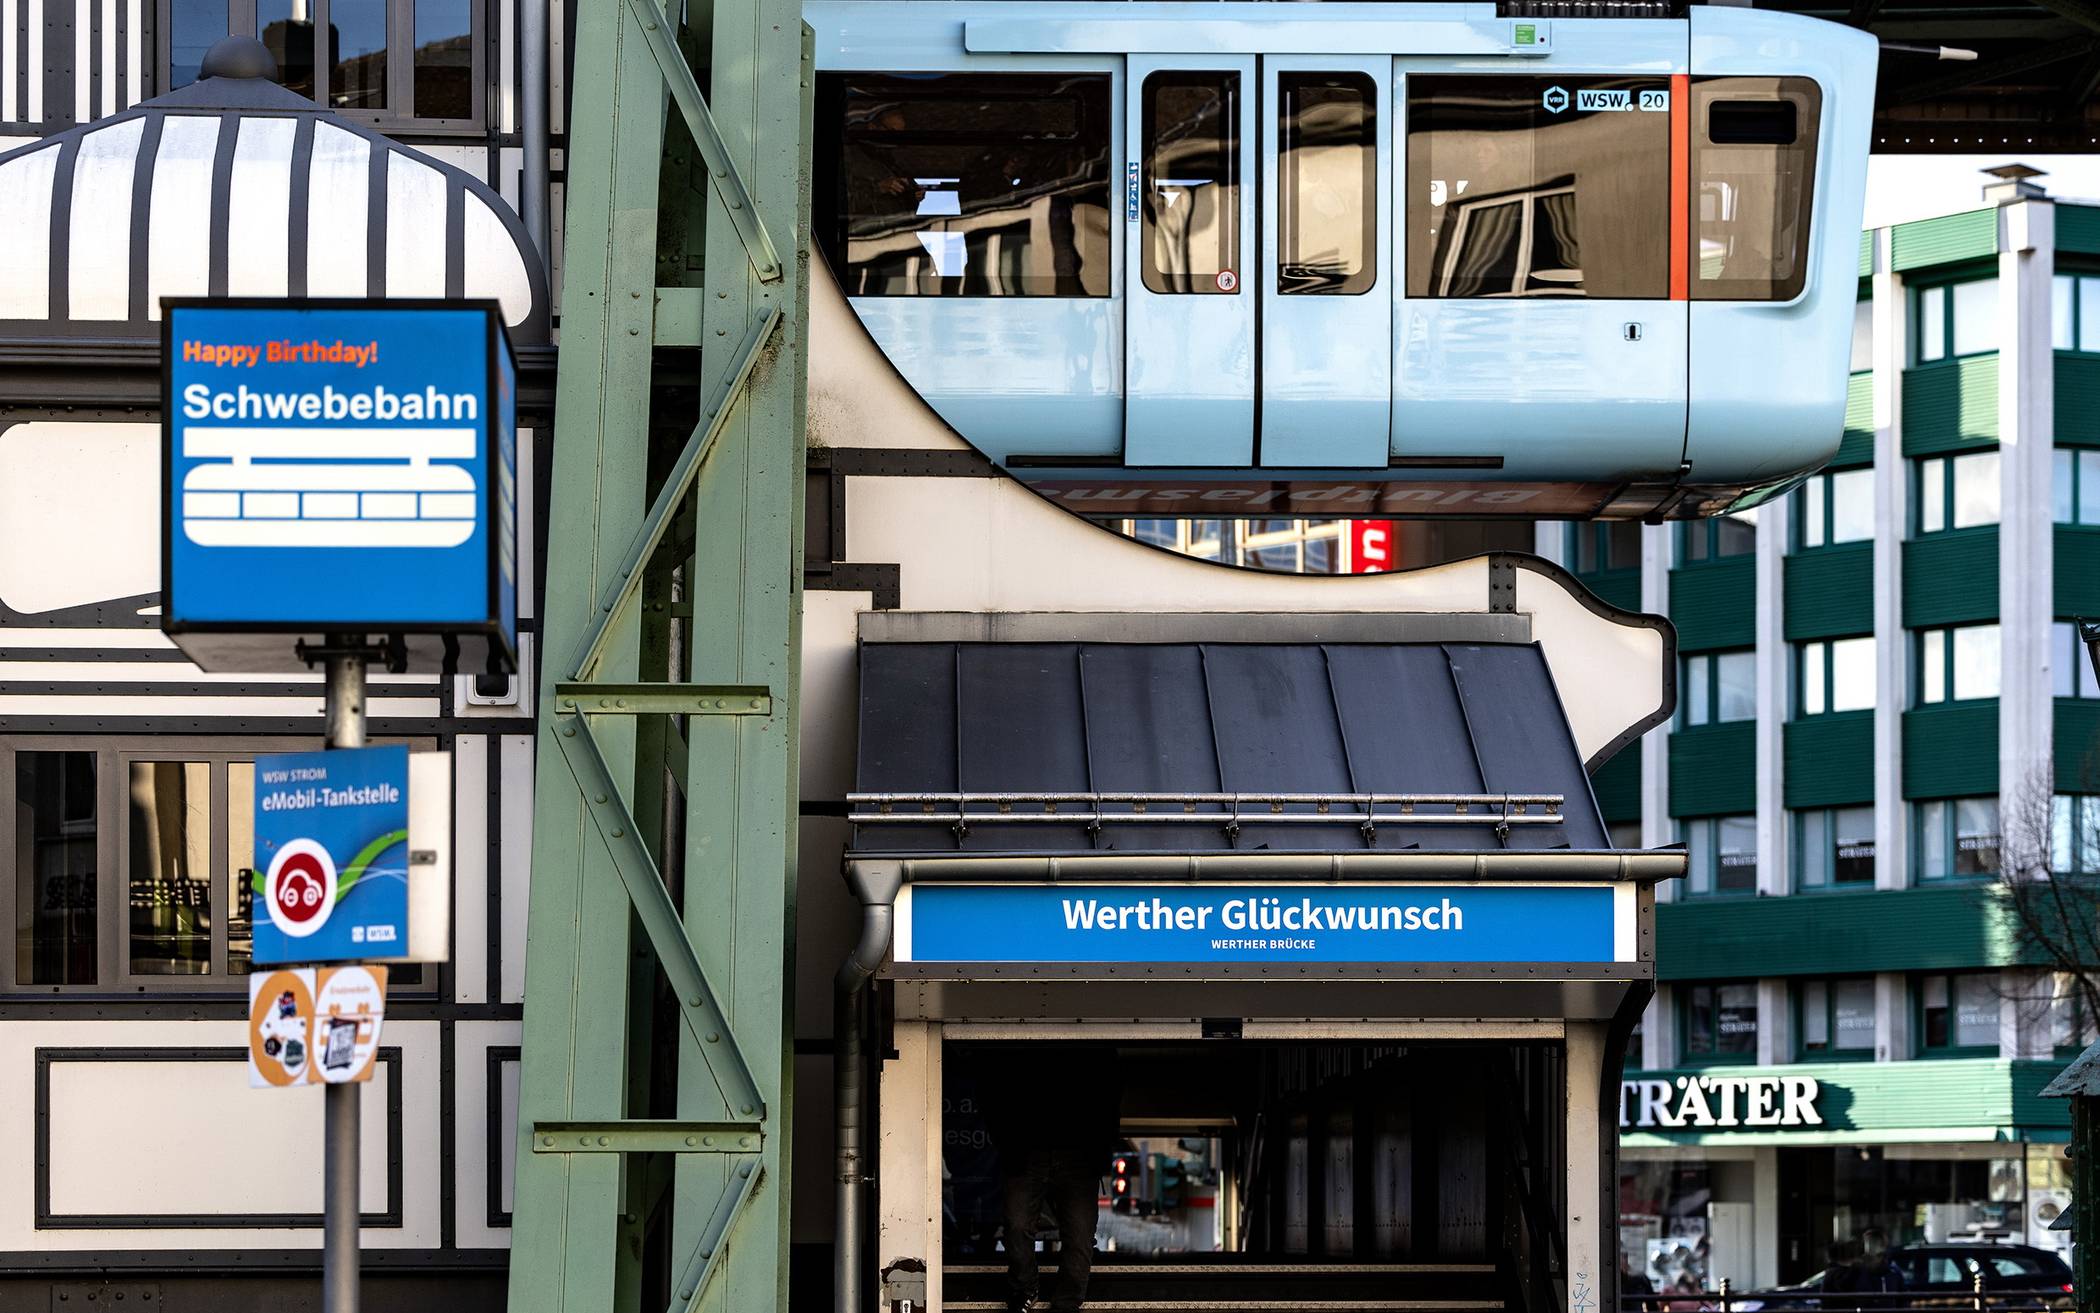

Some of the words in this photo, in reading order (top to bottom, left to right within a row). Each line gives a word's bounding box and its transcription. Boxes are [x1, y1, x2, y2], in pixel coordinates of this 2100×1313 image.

[1642, 94, 1664, 108] 20
[183, 340, 260, 367] Happy
[266, 340, 379, 369] Birthday!
[183, 384, 477, 420] Schwebebahn
[262, 769, 289, 784] WSW
[290, 767, 327, 782] STROM
[262, 783, 399, 811] eMobil-Tankstelle
[1062, 898, 1211, 930] Werther
[1221, 897, 1463, 930] Glückwunsch
[1211, 939, 1267, 949] WERTHER
[1270, 936, 1316, 949] BRÜCKE
